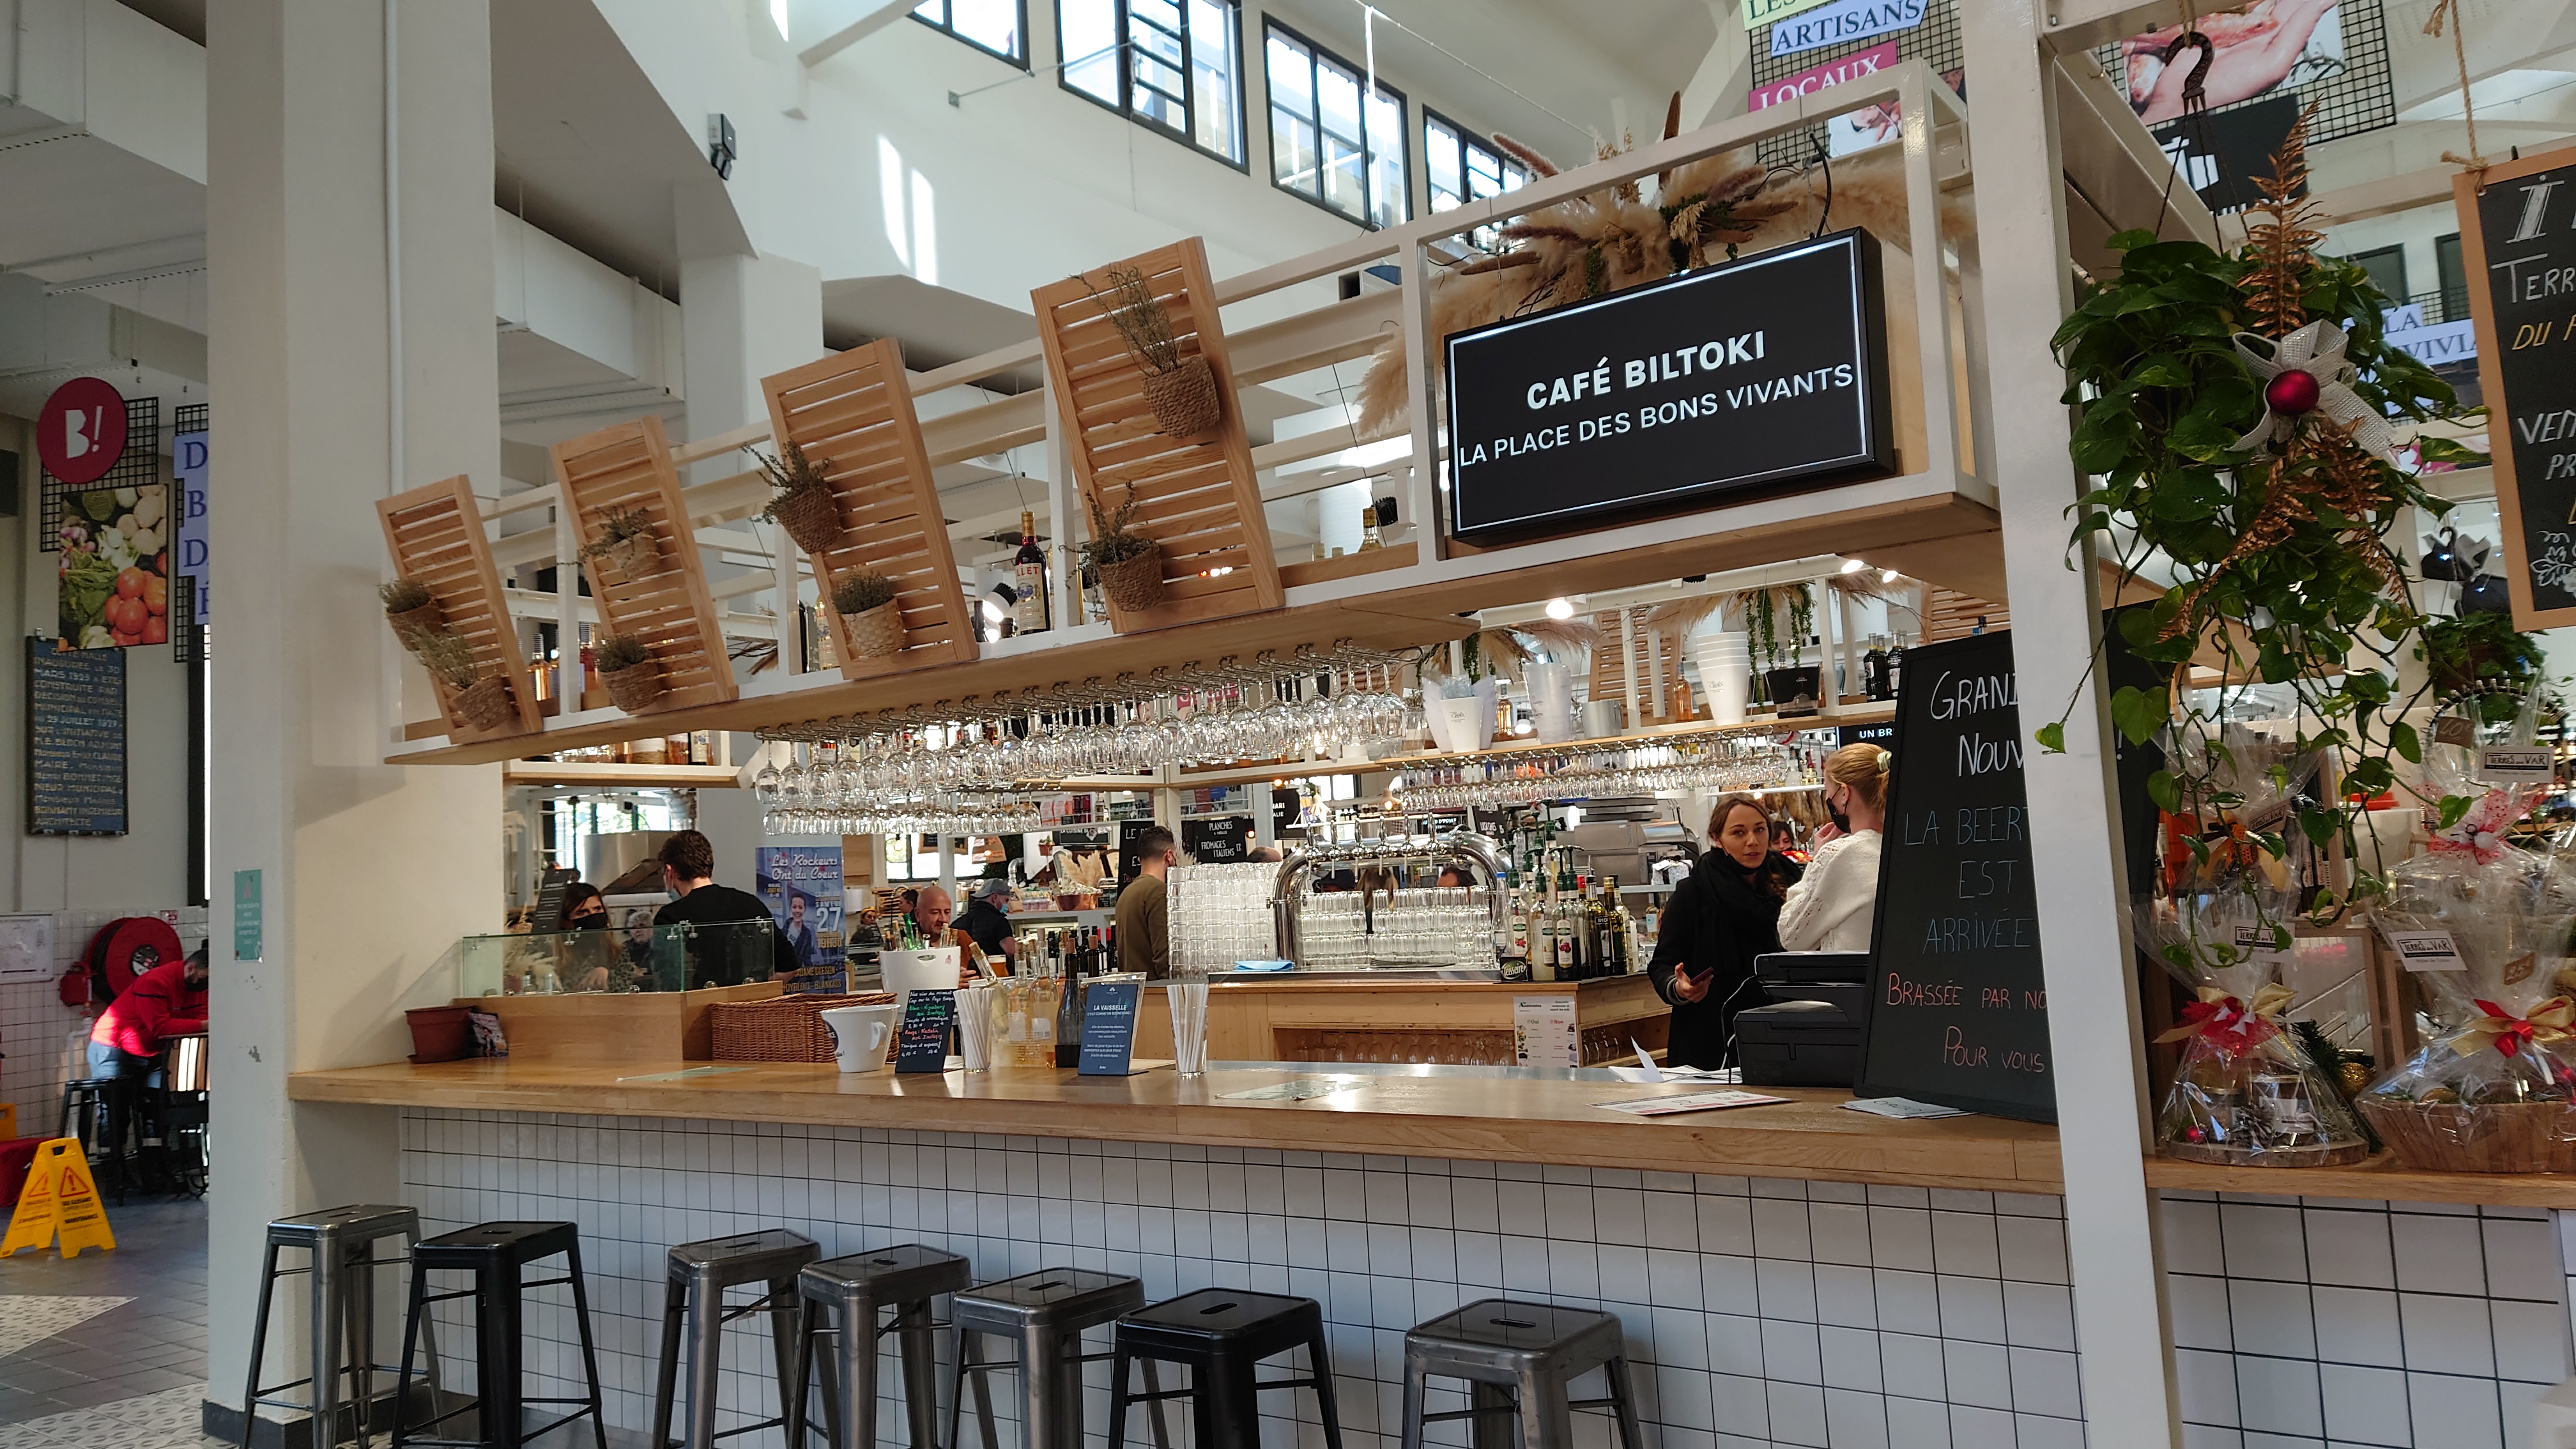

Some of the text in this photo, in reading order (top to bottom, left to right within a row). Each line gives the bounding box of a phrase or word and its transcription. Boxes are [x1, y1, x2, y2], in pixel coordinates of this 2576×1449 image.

[1774, 0, 1920, 53] ARTISANS
[2384, 312, 2423, 334] LA
[2512, 321, 2553, 351] DU
[1526, 330, 1765, 411] CAFÉ BILTOKI
[1459, 364, 1854, 468] LA PLACE DES BONS VIVANTS
[1859, 729, 1874, 739] UN
[1208, 820, 1234, 831] PLANCHES
[1905, 806, 2029, 845] LA BEER
[1200, 839, 1227, 850] FROMAGES
[1213, 847, 1236, 858] ITALIENS
[771, 853, 838, 867] Les Rockeurs
[771, 866, 838, 880] Ont du Coeur
[1959, 859, 2018, 899] EST
[816, 907, 842, 933] 27
[817, 937, 842, 949] 19H30
[2237, 928, 2260, 940] TERR
[1503, 963, 1526, 976] Teisseire
[1886, 972, 1964, 1007] BRASSÉE
[1982, 987, 2011, 1009] PAR
[2002, 1050, 2046, 1073] VOUS
